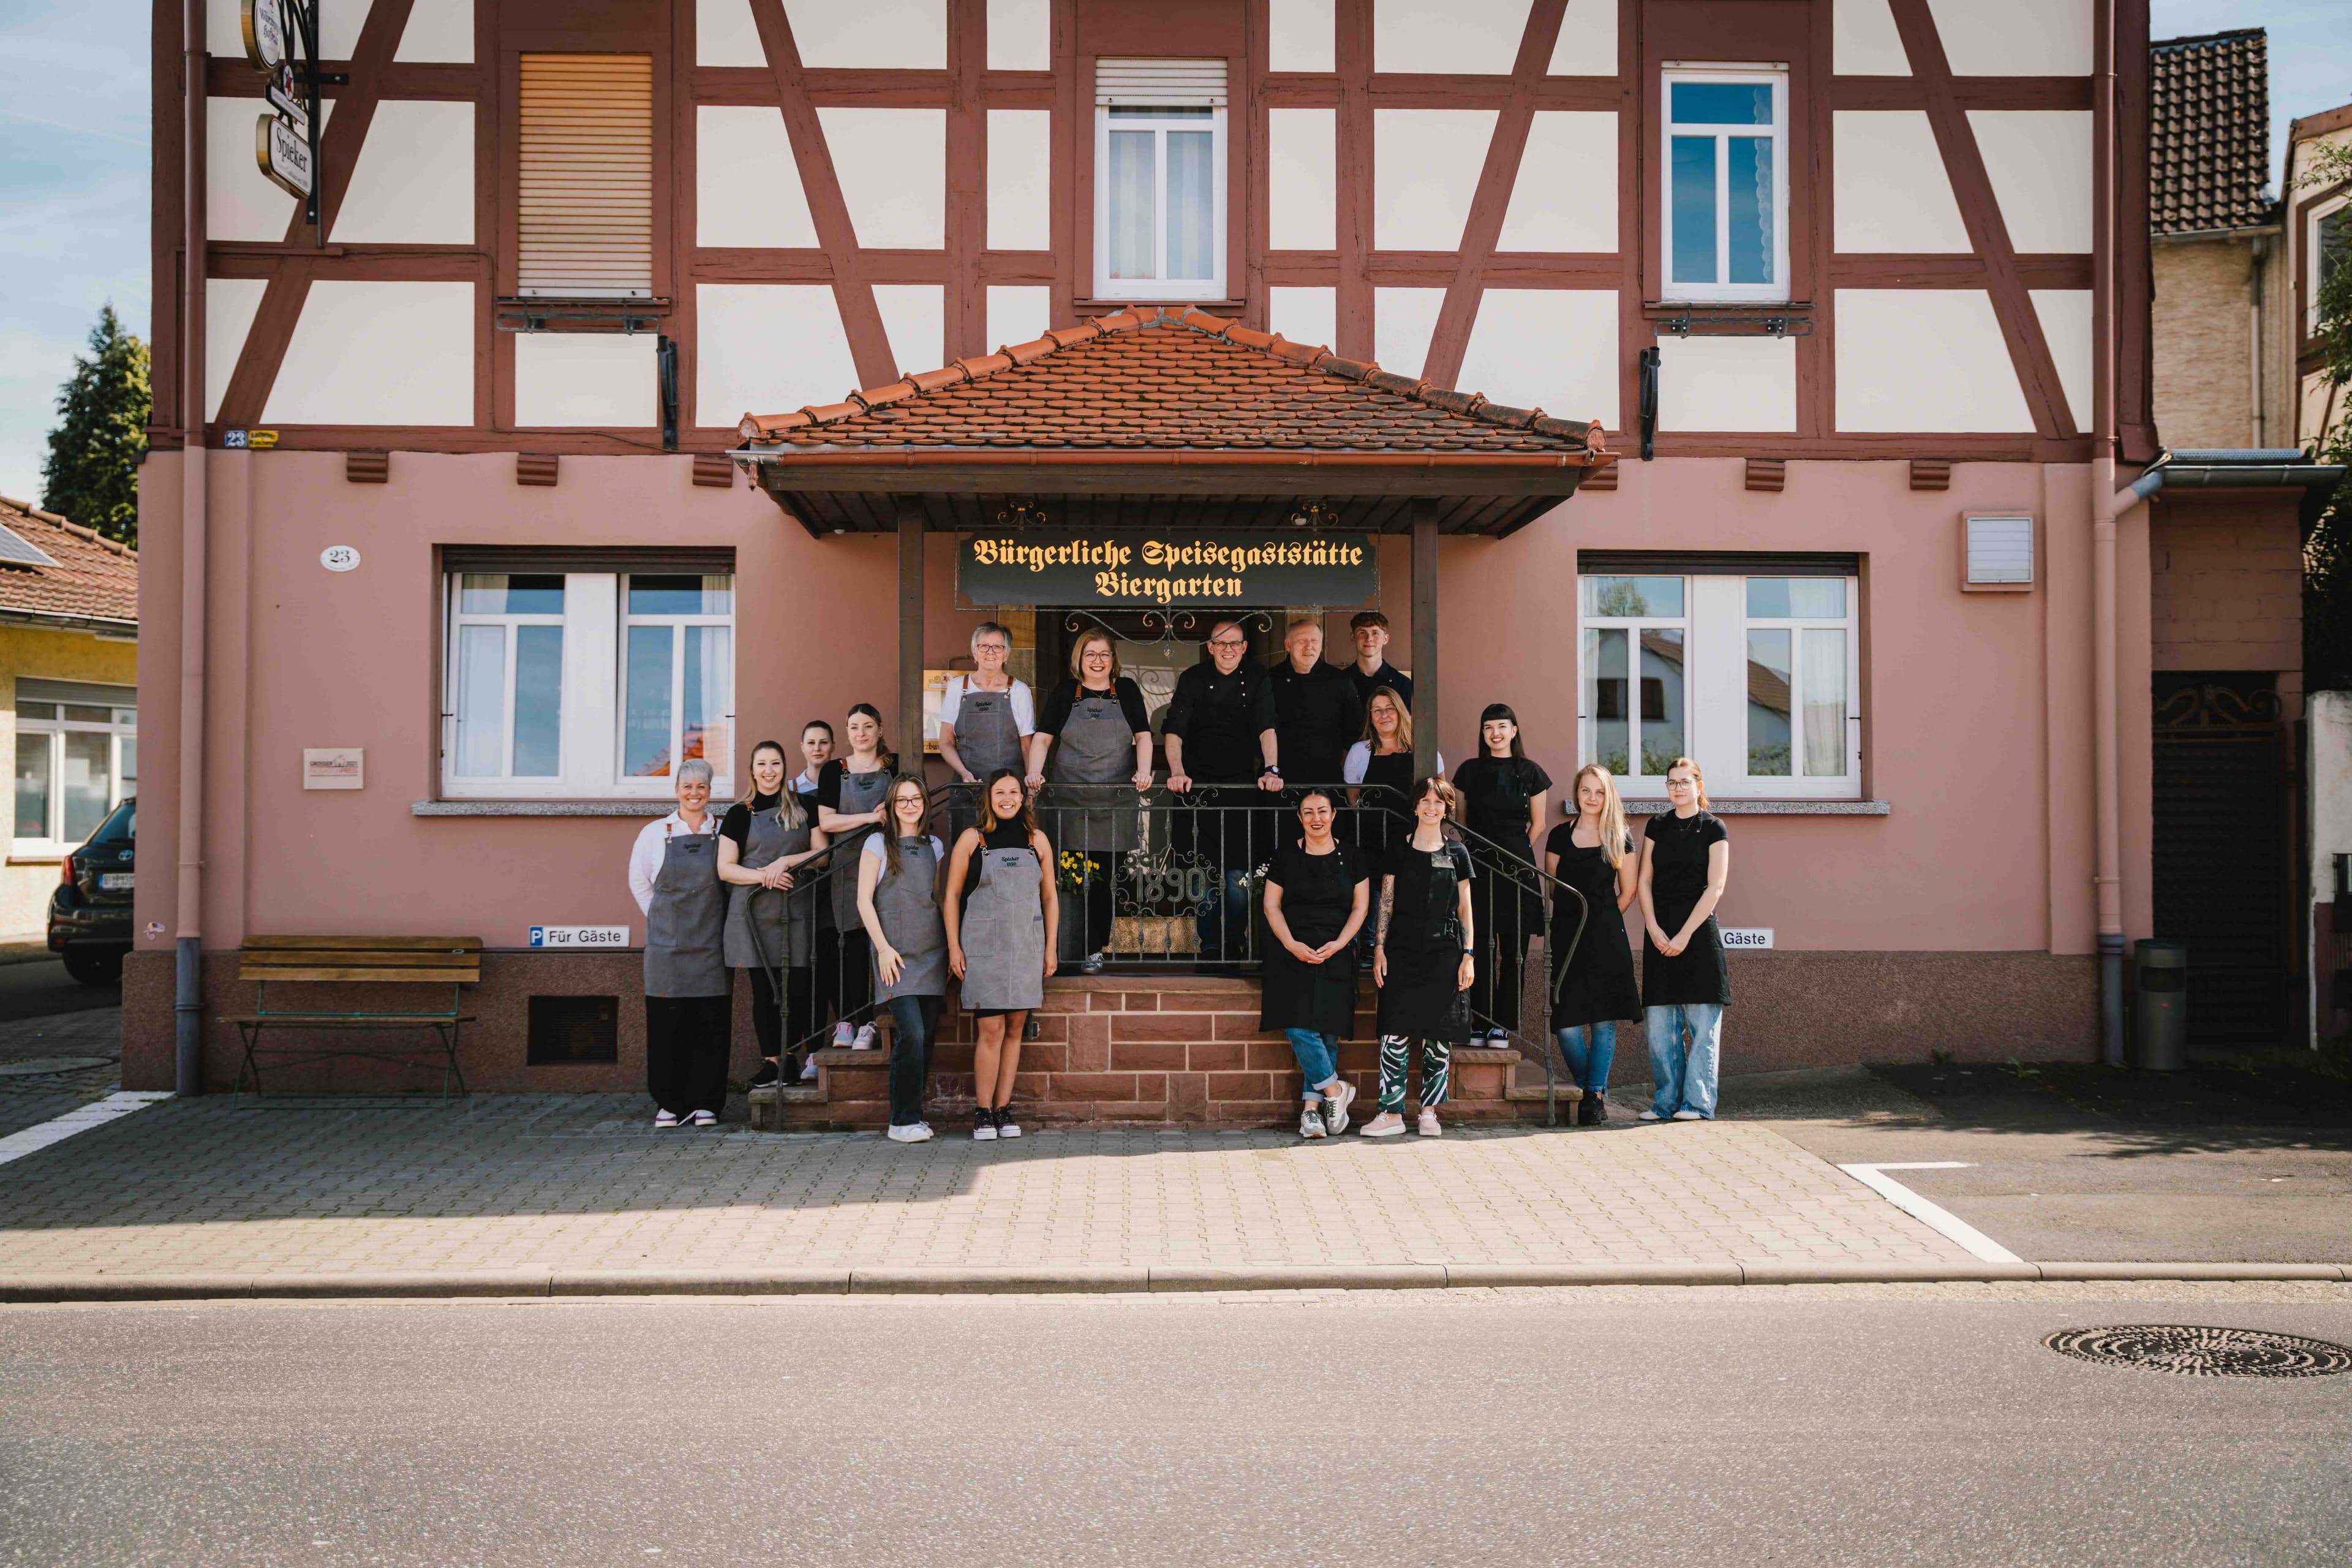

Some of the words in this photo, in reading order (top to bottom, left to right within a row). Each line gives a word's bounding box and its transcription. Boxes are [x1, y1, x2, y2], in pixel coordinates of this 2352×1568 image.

[276, 127, 307, 173] Spieker
[227, 432, 245, 447] 23
[330, 549, 350, 564] 23
[973, 539, 1131, 572] Bürgerliche
[1142, 540, 1363, 573] Speisegaststätte
[1095, 571, 1243, 604] Biergarten
[1130, 867, 1205, 903] 1890
[532, 930, 543, 944] P
[549, 930, 572, 943] Für
[579, 930, 621, 943] Gäste
[1724, 932, 1765, 944] Gäste
